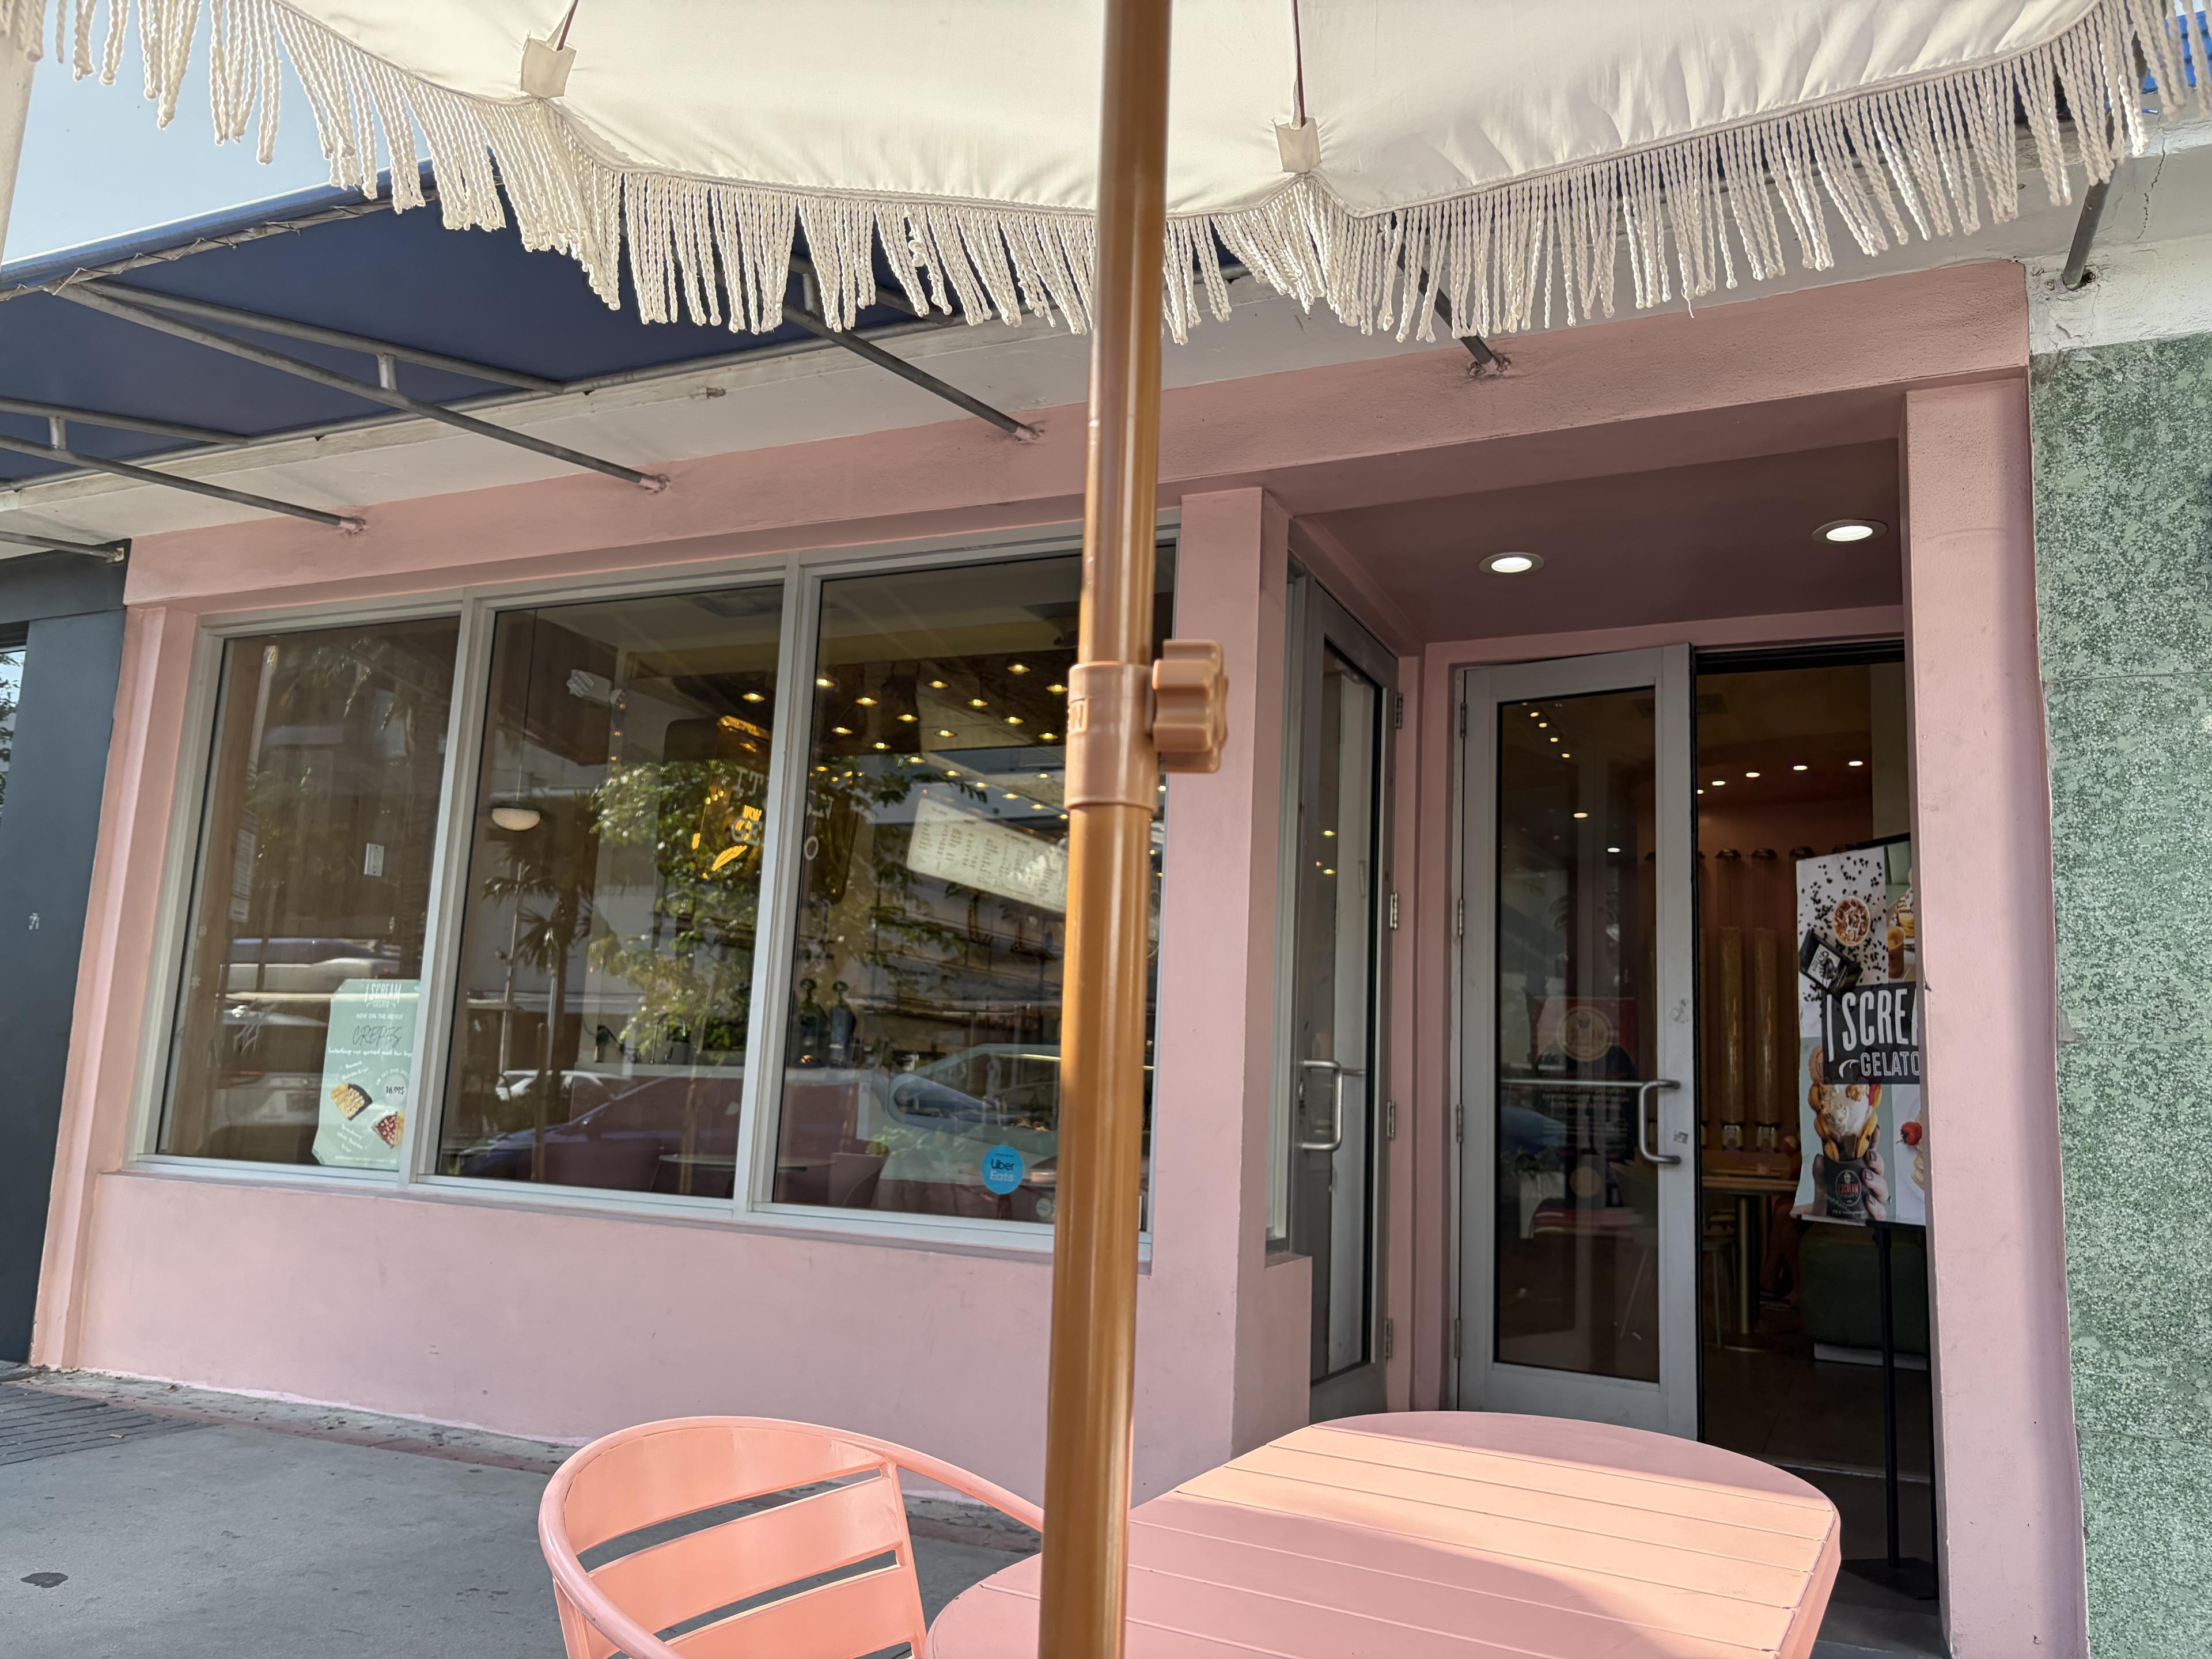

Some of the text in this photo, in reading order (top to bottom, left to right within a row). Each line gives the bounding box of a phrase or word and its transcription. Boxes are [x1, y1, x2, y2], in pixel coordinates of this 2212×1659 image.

[369, 983, 402, 1004] SCREAM
[352, 1025, 403, 1048] CREPES
[1827, 994, 1834, 1062] I
[1860, 1051, 1920, 1077] GELATO
[991, 1158, 1015, 1171] Uber
[990, 1170, 1014, 1182] Eats
